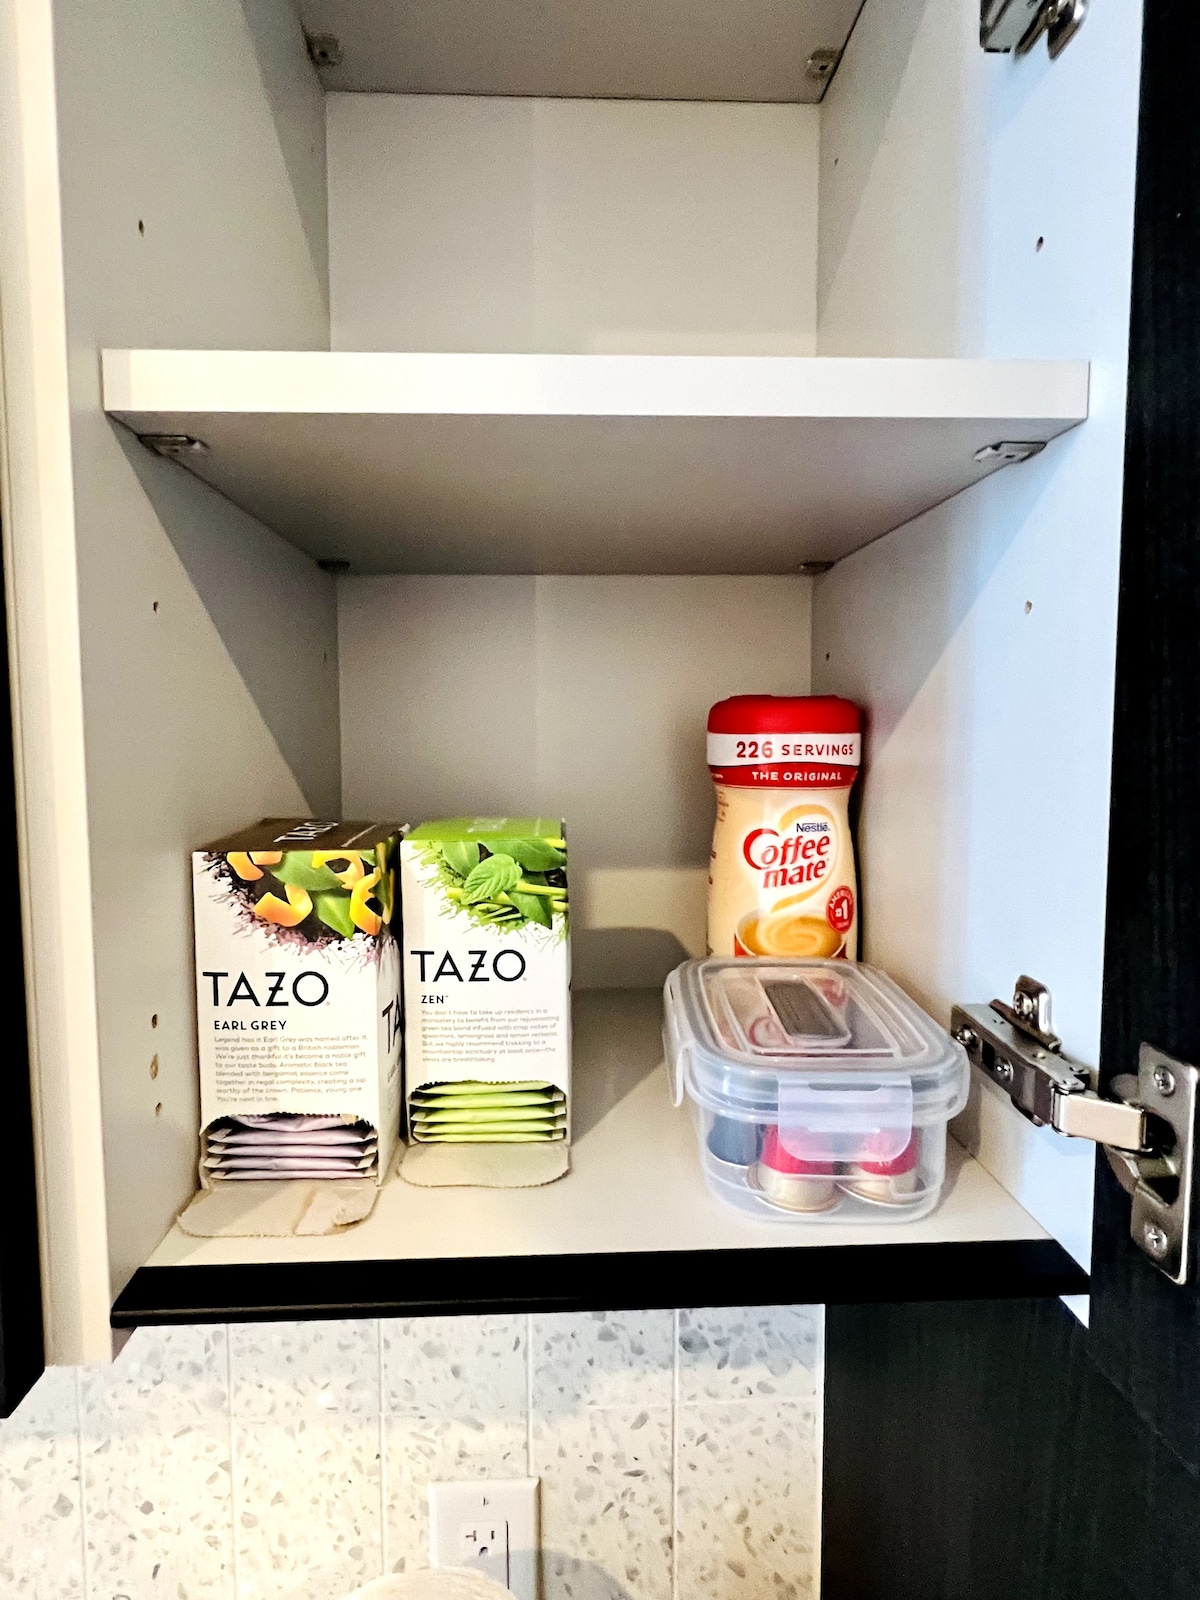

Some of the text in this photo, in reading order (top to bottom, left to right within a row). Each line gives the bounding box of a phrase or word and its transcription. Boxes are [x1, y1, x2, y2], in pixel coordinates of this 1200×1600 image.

[736, 741, 853, 758] 226 SERVINGS
[752, 771, 841, 781] THE ORIGINAL
[743, 828, 830, 870] Coffee
[763, 860, 826, 888] mate
[410, 949, 526, 982] TAZO
[202, 971, 329, 1007] TAZO
[214, 1020, 287, 1030] EARL GREY
[382, 993, 402, 1054] TA
[279, 1036, 296, 1044] Grey
